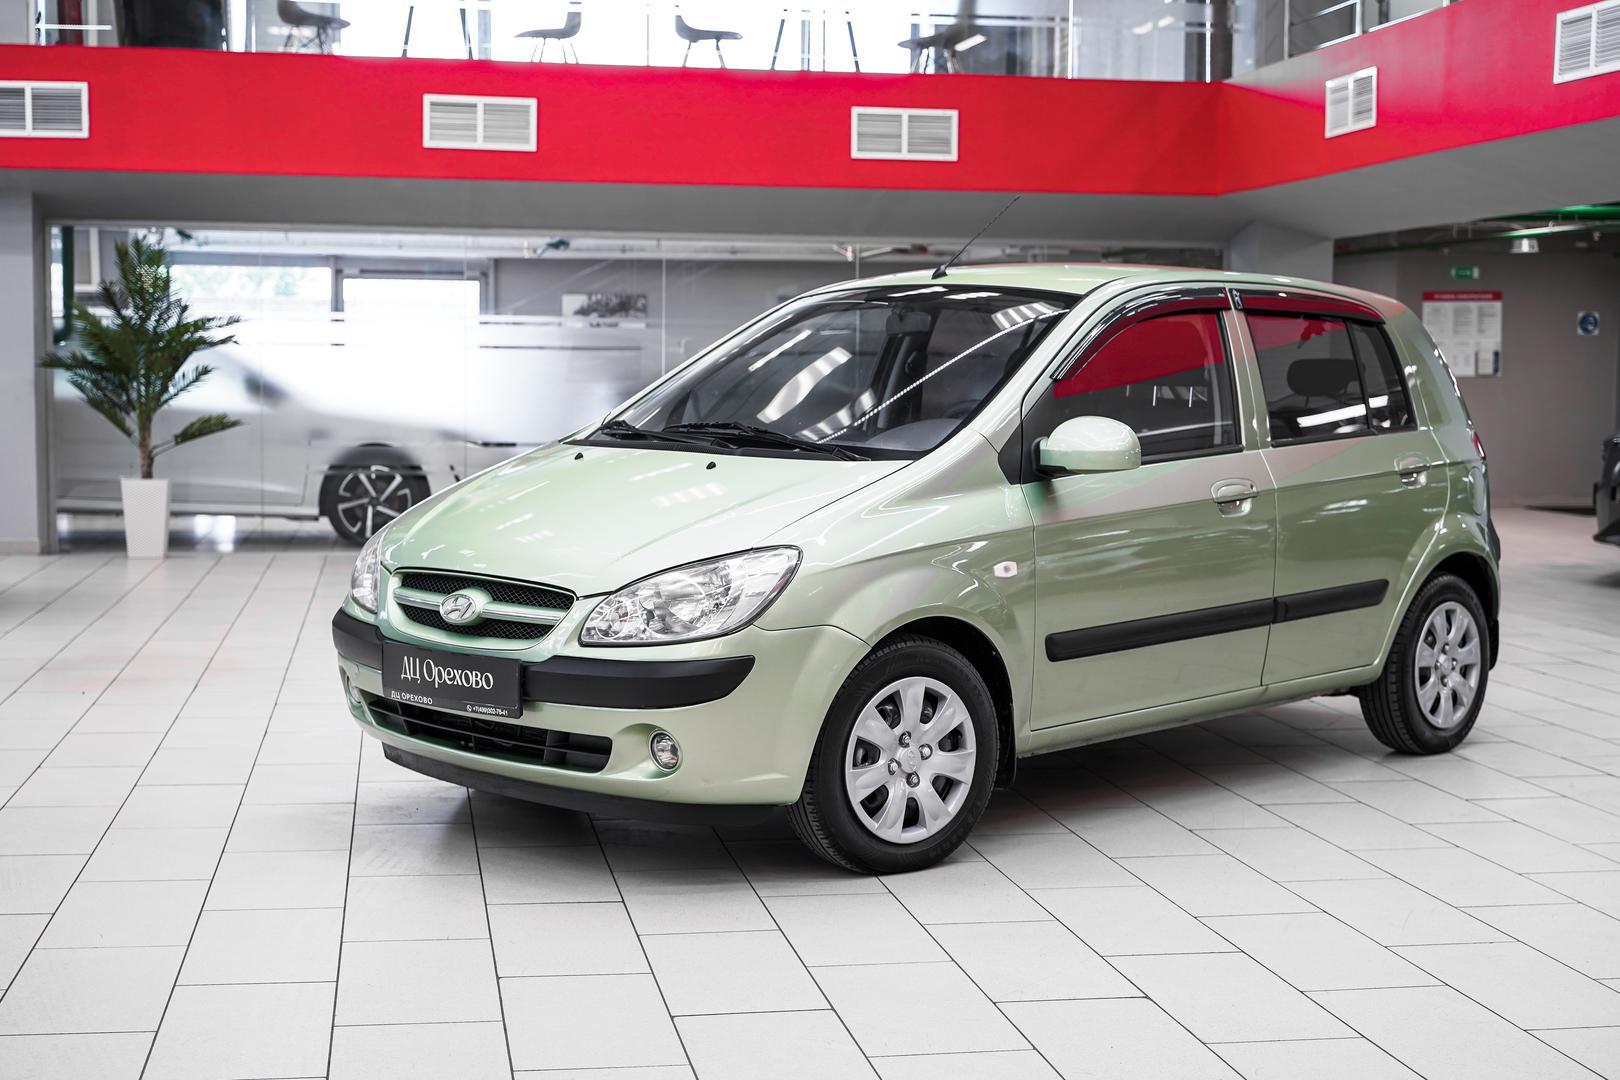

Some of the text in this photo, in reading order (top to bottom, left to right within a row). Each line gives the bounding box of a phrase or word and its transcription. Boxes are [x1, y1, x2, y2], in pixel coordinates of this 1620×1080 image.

[401, 655, 494, 690] ДЦ Орехово
[391, 690, 433, 705] ДЦ ОРЕХОВО
